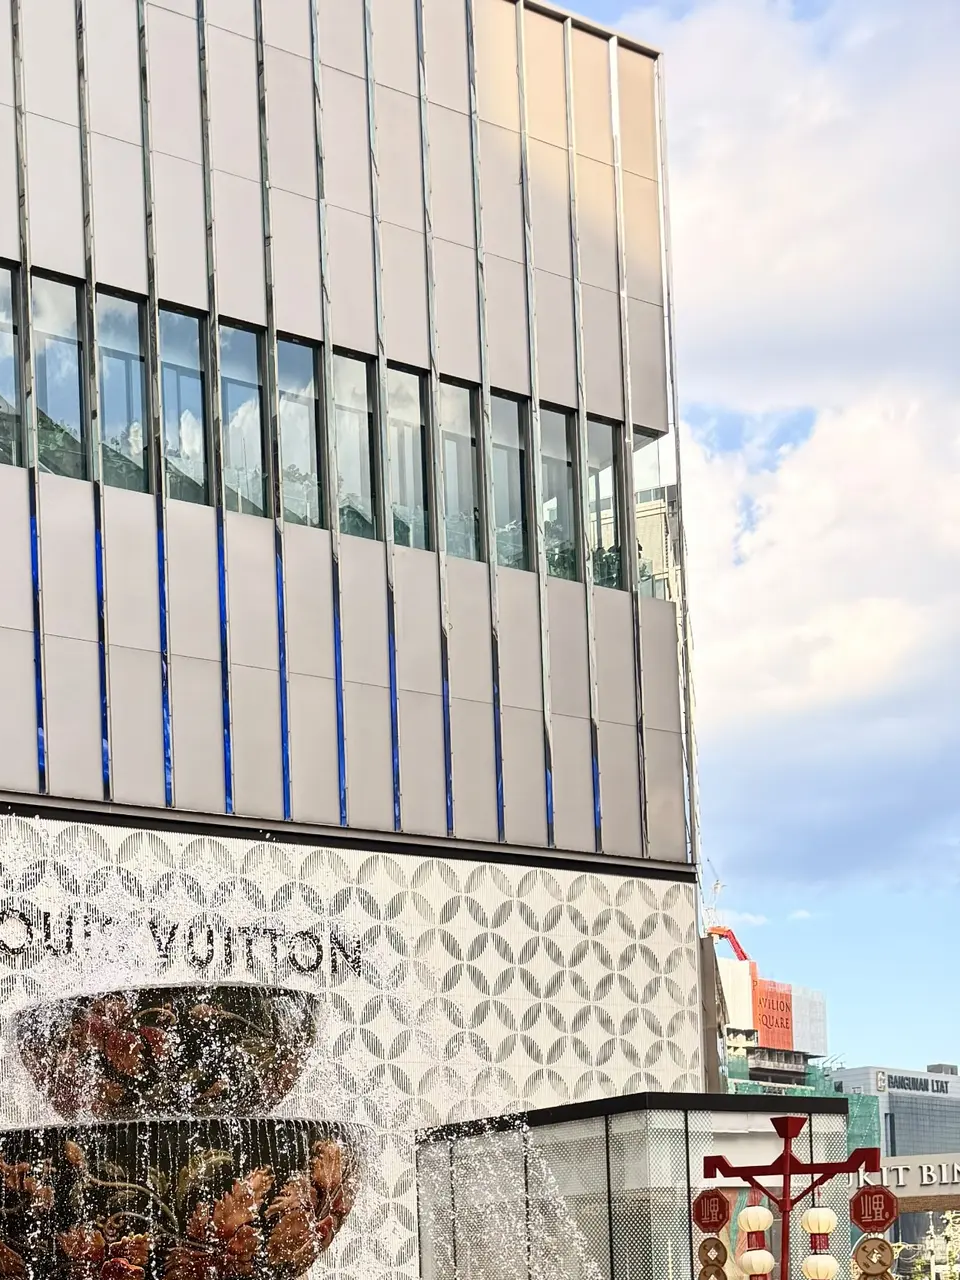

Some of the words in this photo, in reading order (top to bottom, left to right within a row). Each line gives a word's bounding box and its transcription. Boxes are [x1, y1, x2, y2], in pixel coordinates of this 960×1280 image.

[149, 919, 362, 977] VUITTON
[887, 1074, 929, 1092] BANGUNAN
[930, 1079, 950, 1094] LTAT
